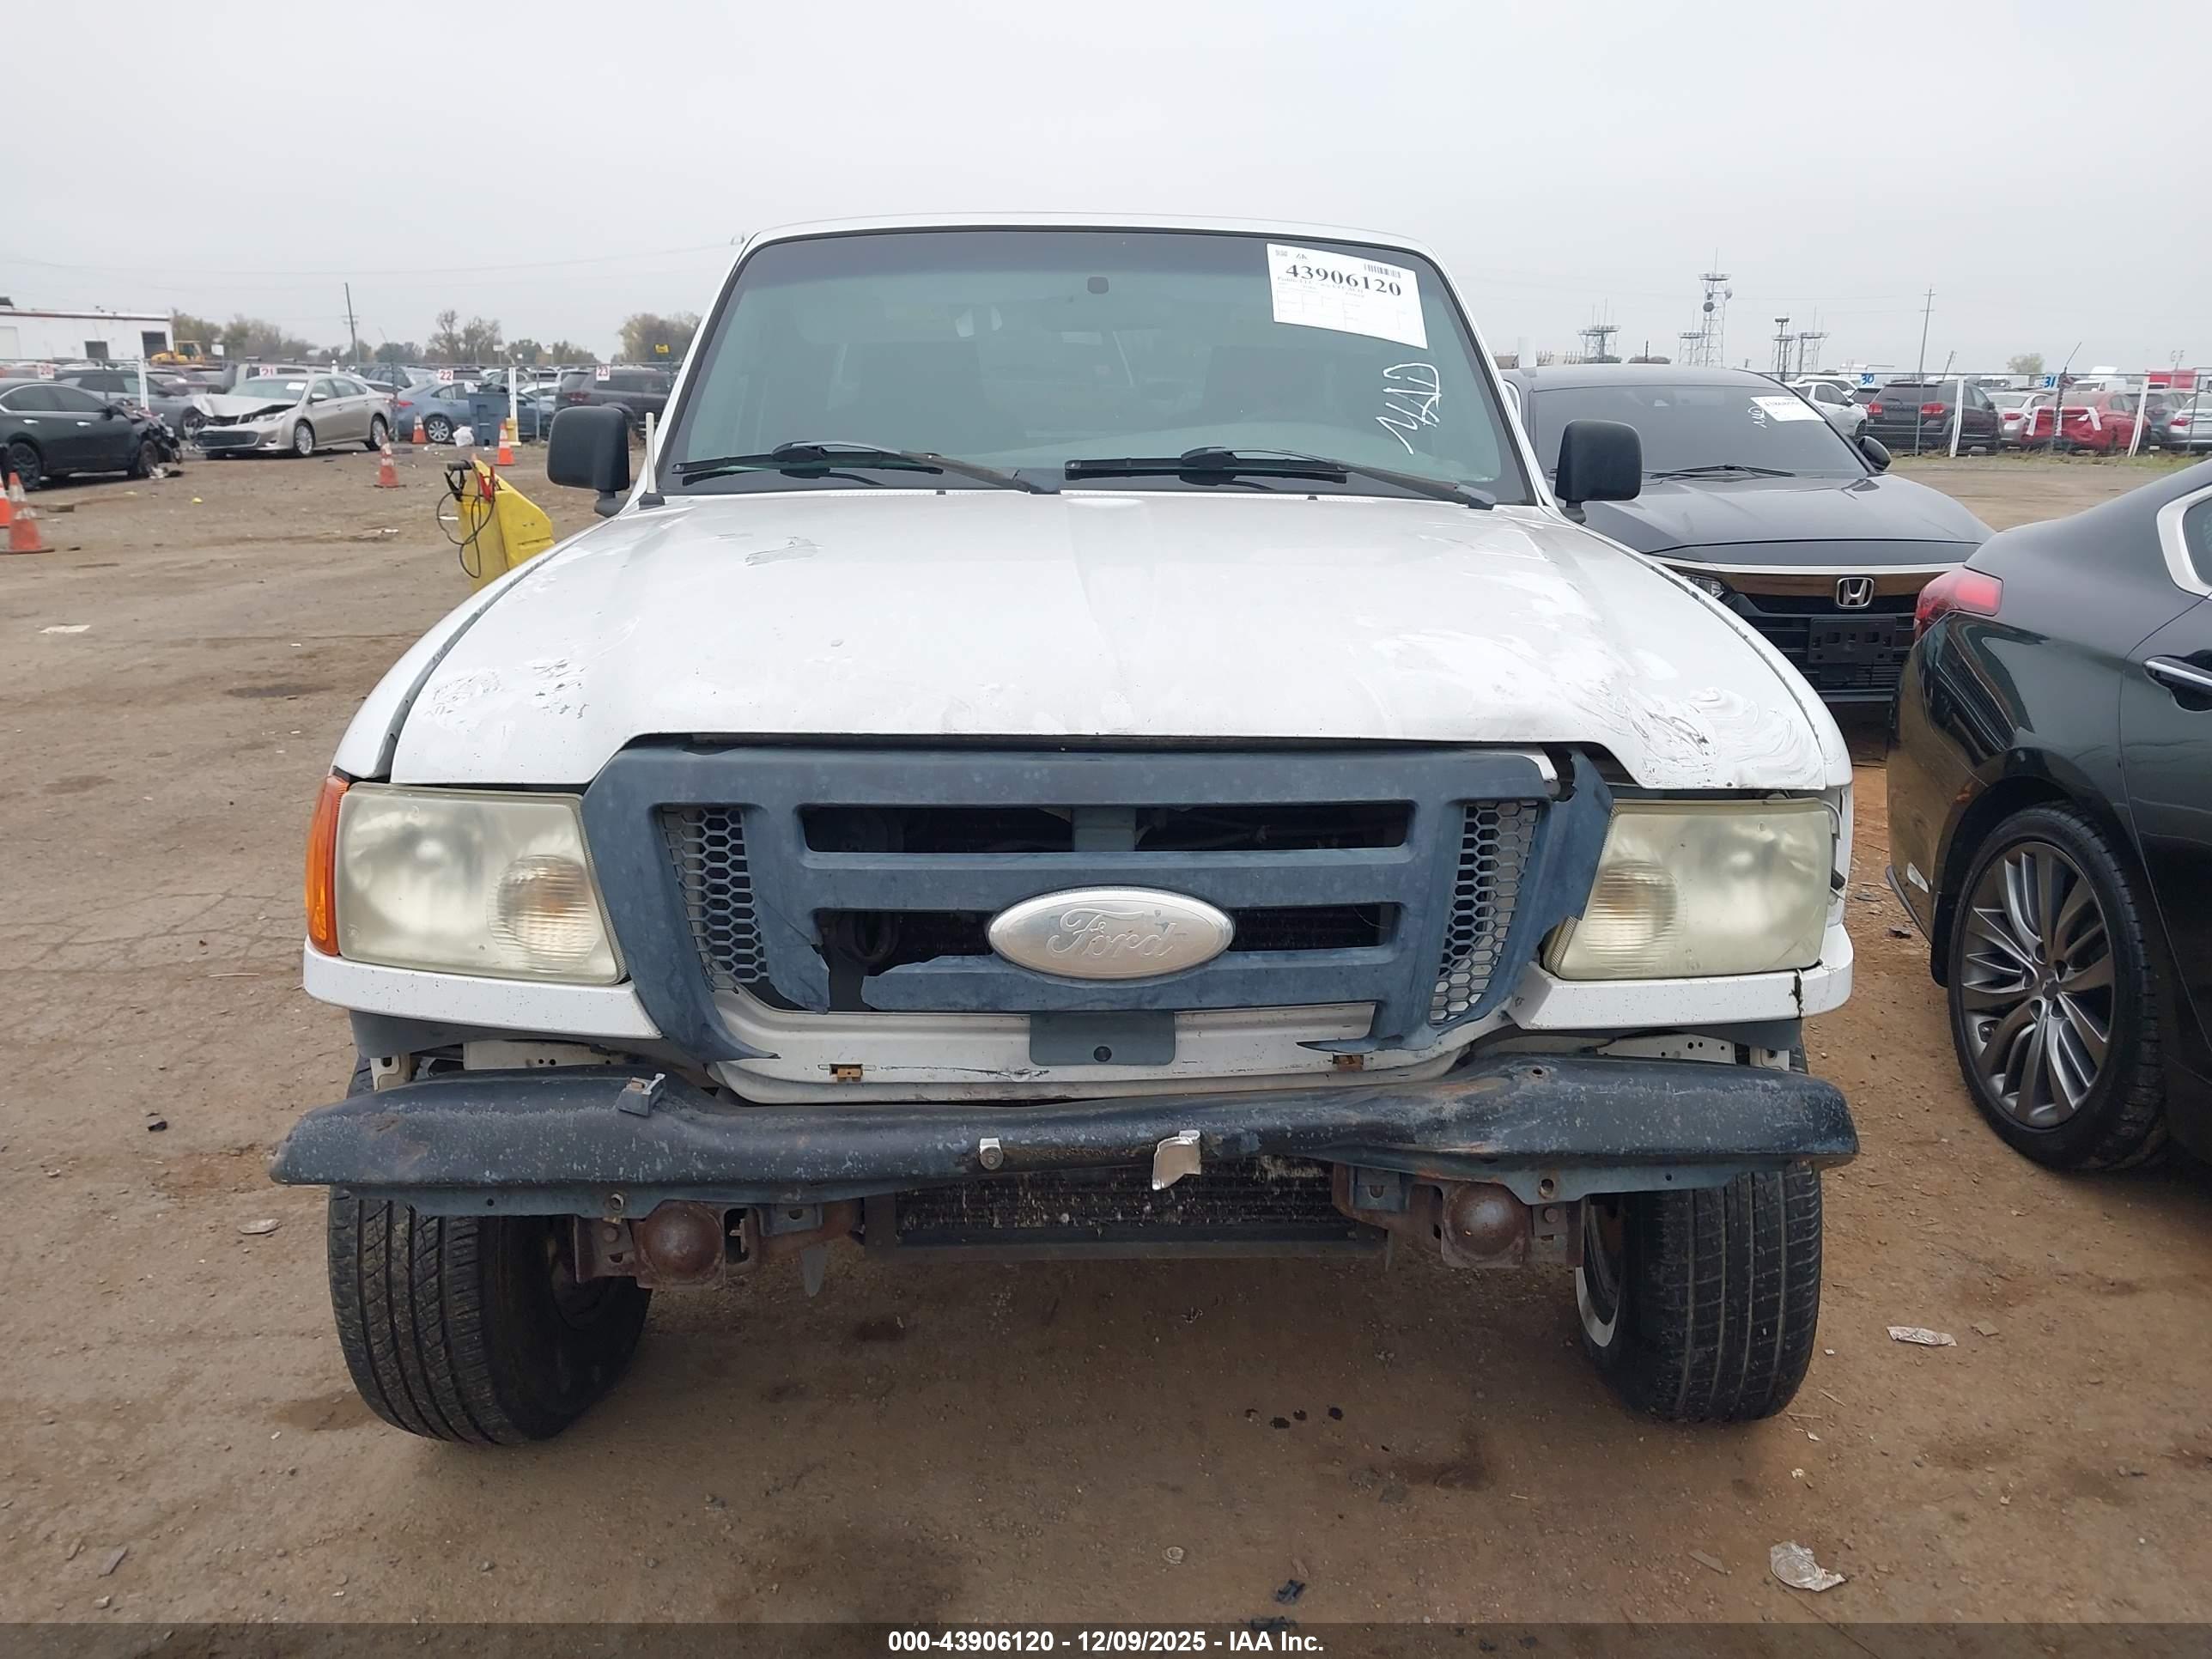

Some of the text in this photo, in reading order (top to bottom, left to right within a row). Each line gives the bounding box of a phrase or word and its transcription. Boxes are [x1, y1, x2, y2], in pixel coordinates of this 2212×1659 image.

[1285, 264, 1401, 296] 43906120
[440, 370, 453, 380] 22
[599, 367, 608, 377] 23
[1862, 374, 1875, 385] 30
[2045, 376, 2057, 387] 31
[1047, 908, 1177, 957] Ford
